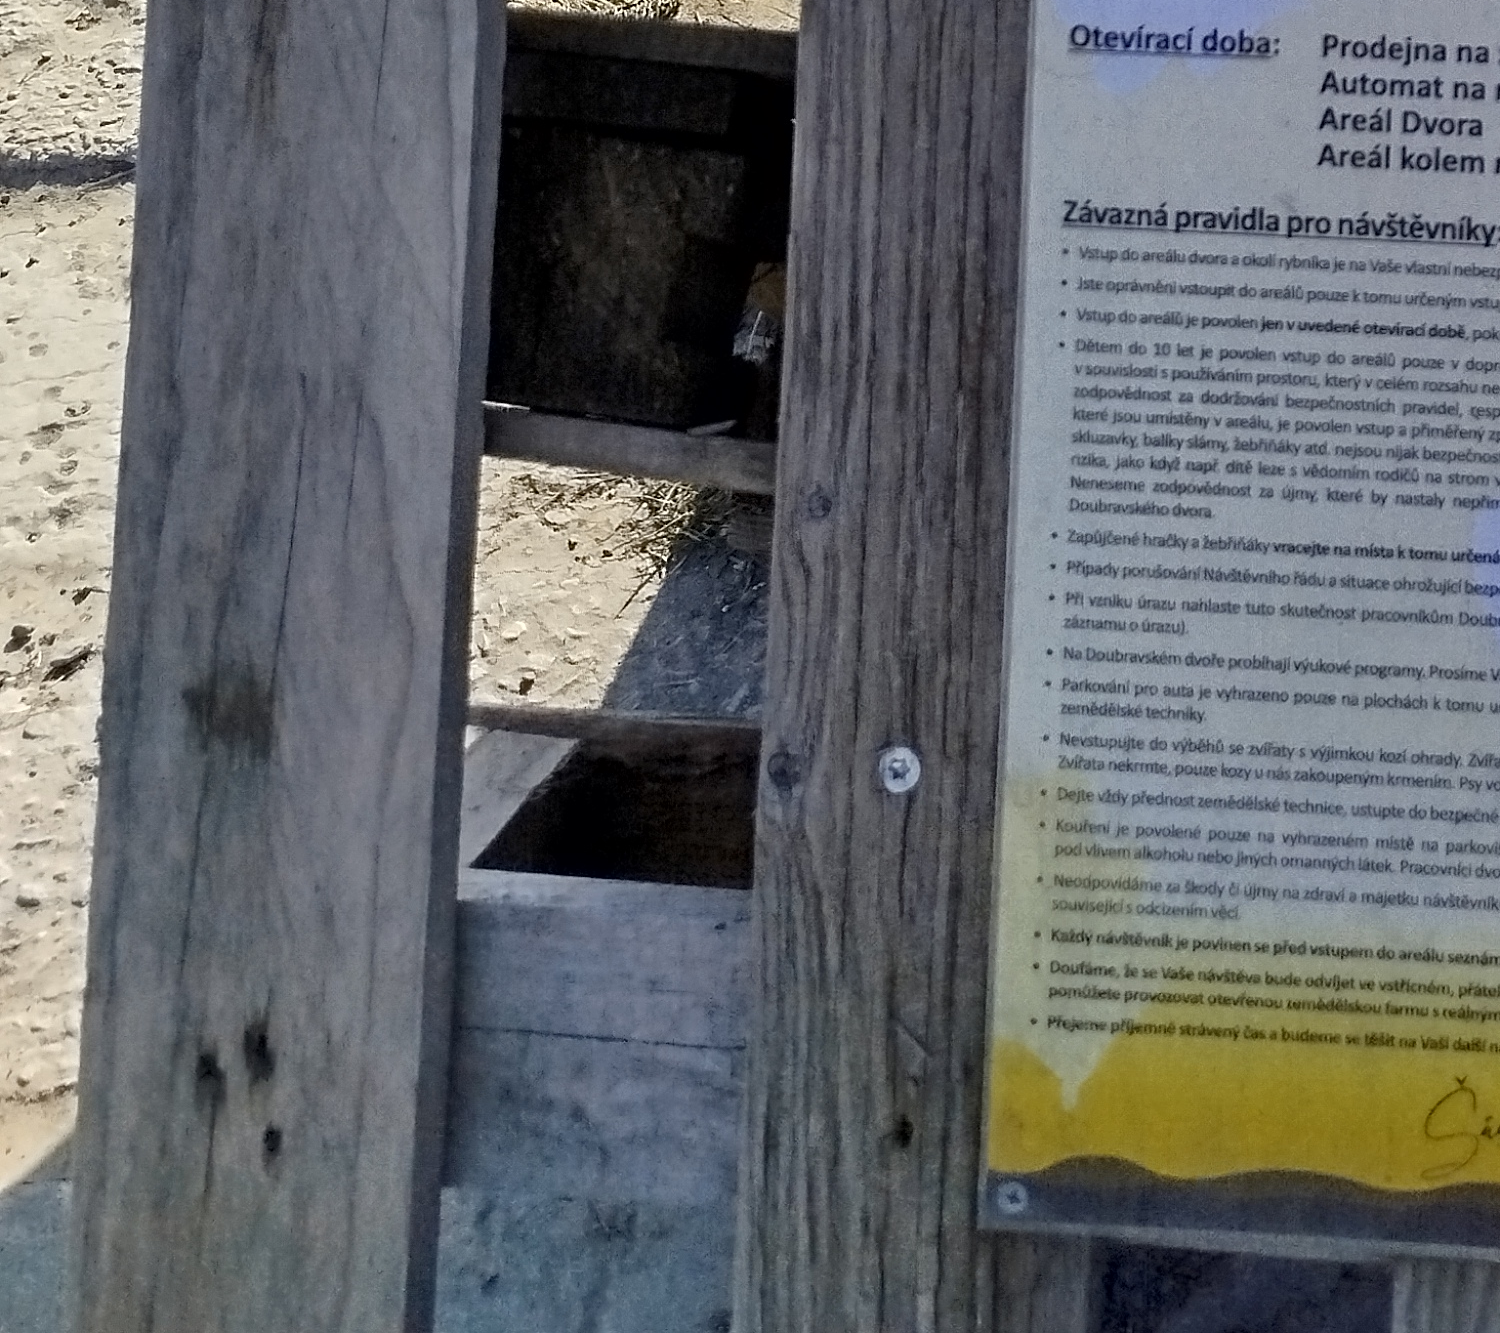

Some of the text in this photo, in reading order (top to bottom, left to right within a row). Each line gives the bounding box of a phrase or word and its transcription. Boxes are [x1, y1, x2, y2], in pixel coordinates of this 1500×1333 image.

[1069, 24, 1280, 60] Otevírací doba:
[1321, 33, 1447, 66] Prodejna
[1455, 44, 1490, 64] na
[1319, 70, 1444, 99] Automat
[1452, 80, 1486, 101] na
[1318, 106, 1483, 138] Areál Dvora
[1316, 143, 1391, 170] Areál
[1400, 145, 1485, 174] kolem
[1062, 199, 1168, 232] Závazná
[1173, 206, 1280, 236] pravidla
[1285, 214, 1332, 240] pro
[1068, 497, 1170, 517] Doubravského
[1062, 613, 1127, 632] záznamu
[1128, 620, 1140, 633] o
[1062, 646, 1083, 661] Na
[1085, 646, 1183, 666] Doubravském
[1183, 651, 1226, 669] dvoře
[1227, 654, 1291, 675] probíhají
[1292, 657, 1353, 675] výukové
[1428, 664, 1488, 682] Prosíme
[1060, 701, 1144, 719] zemědělské
[1057, 786, 1095, 805] Dejte
[1097, 788, 1129, 807] vždy
[1130, 789, 1196, 808] přednost
[1196, 794, 1281, 813] zemědělské
[1350, 803, 1406, 821] ustupte
[1407, 803, 1428, 820] do
[1429, 805, 1500, 825] bezpečné
